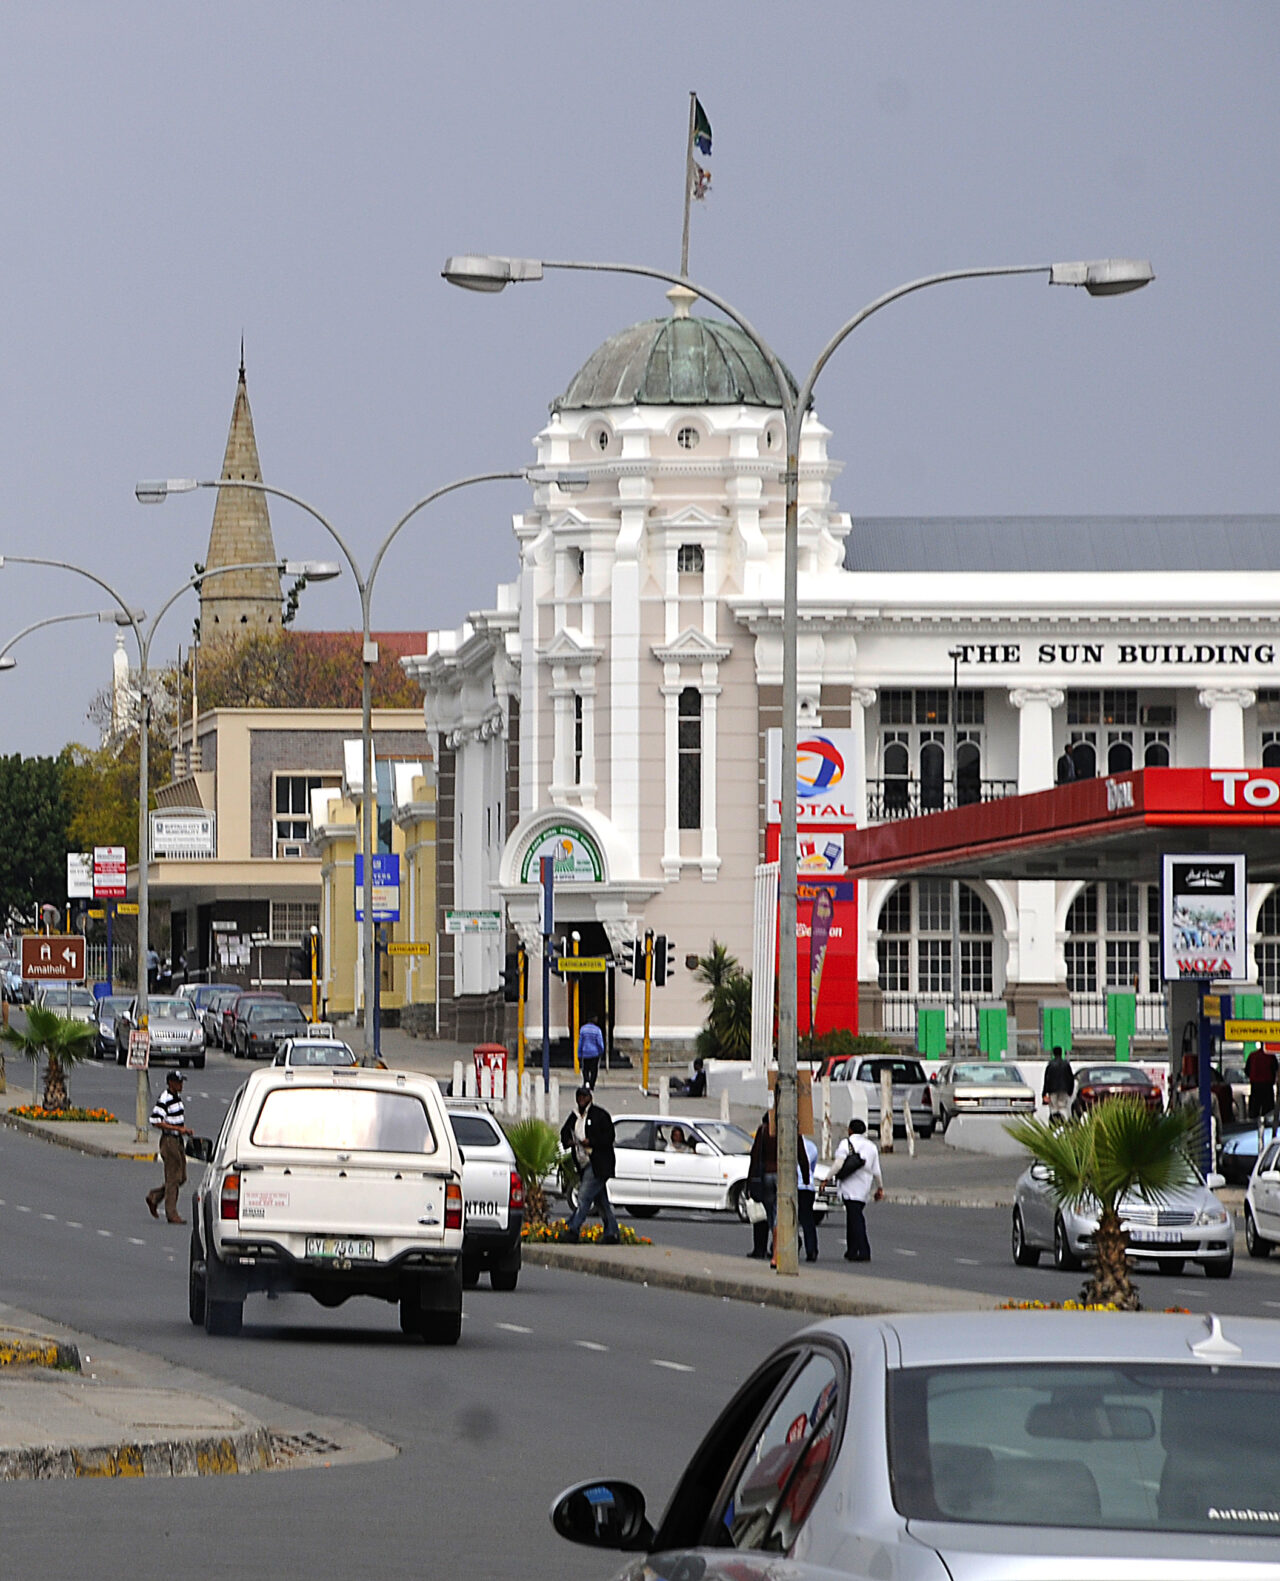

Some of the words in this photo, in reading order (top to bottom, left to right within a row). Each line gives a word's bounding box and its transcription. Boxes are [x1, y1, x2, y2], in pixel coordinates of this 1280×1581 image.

[957, 645, 1020, 663] THE
[1038, 644, 1104, 663] SUN
[1118, 645, 1275, 663] BUILDING
[1176, 959, 1233, 973] WOZA
